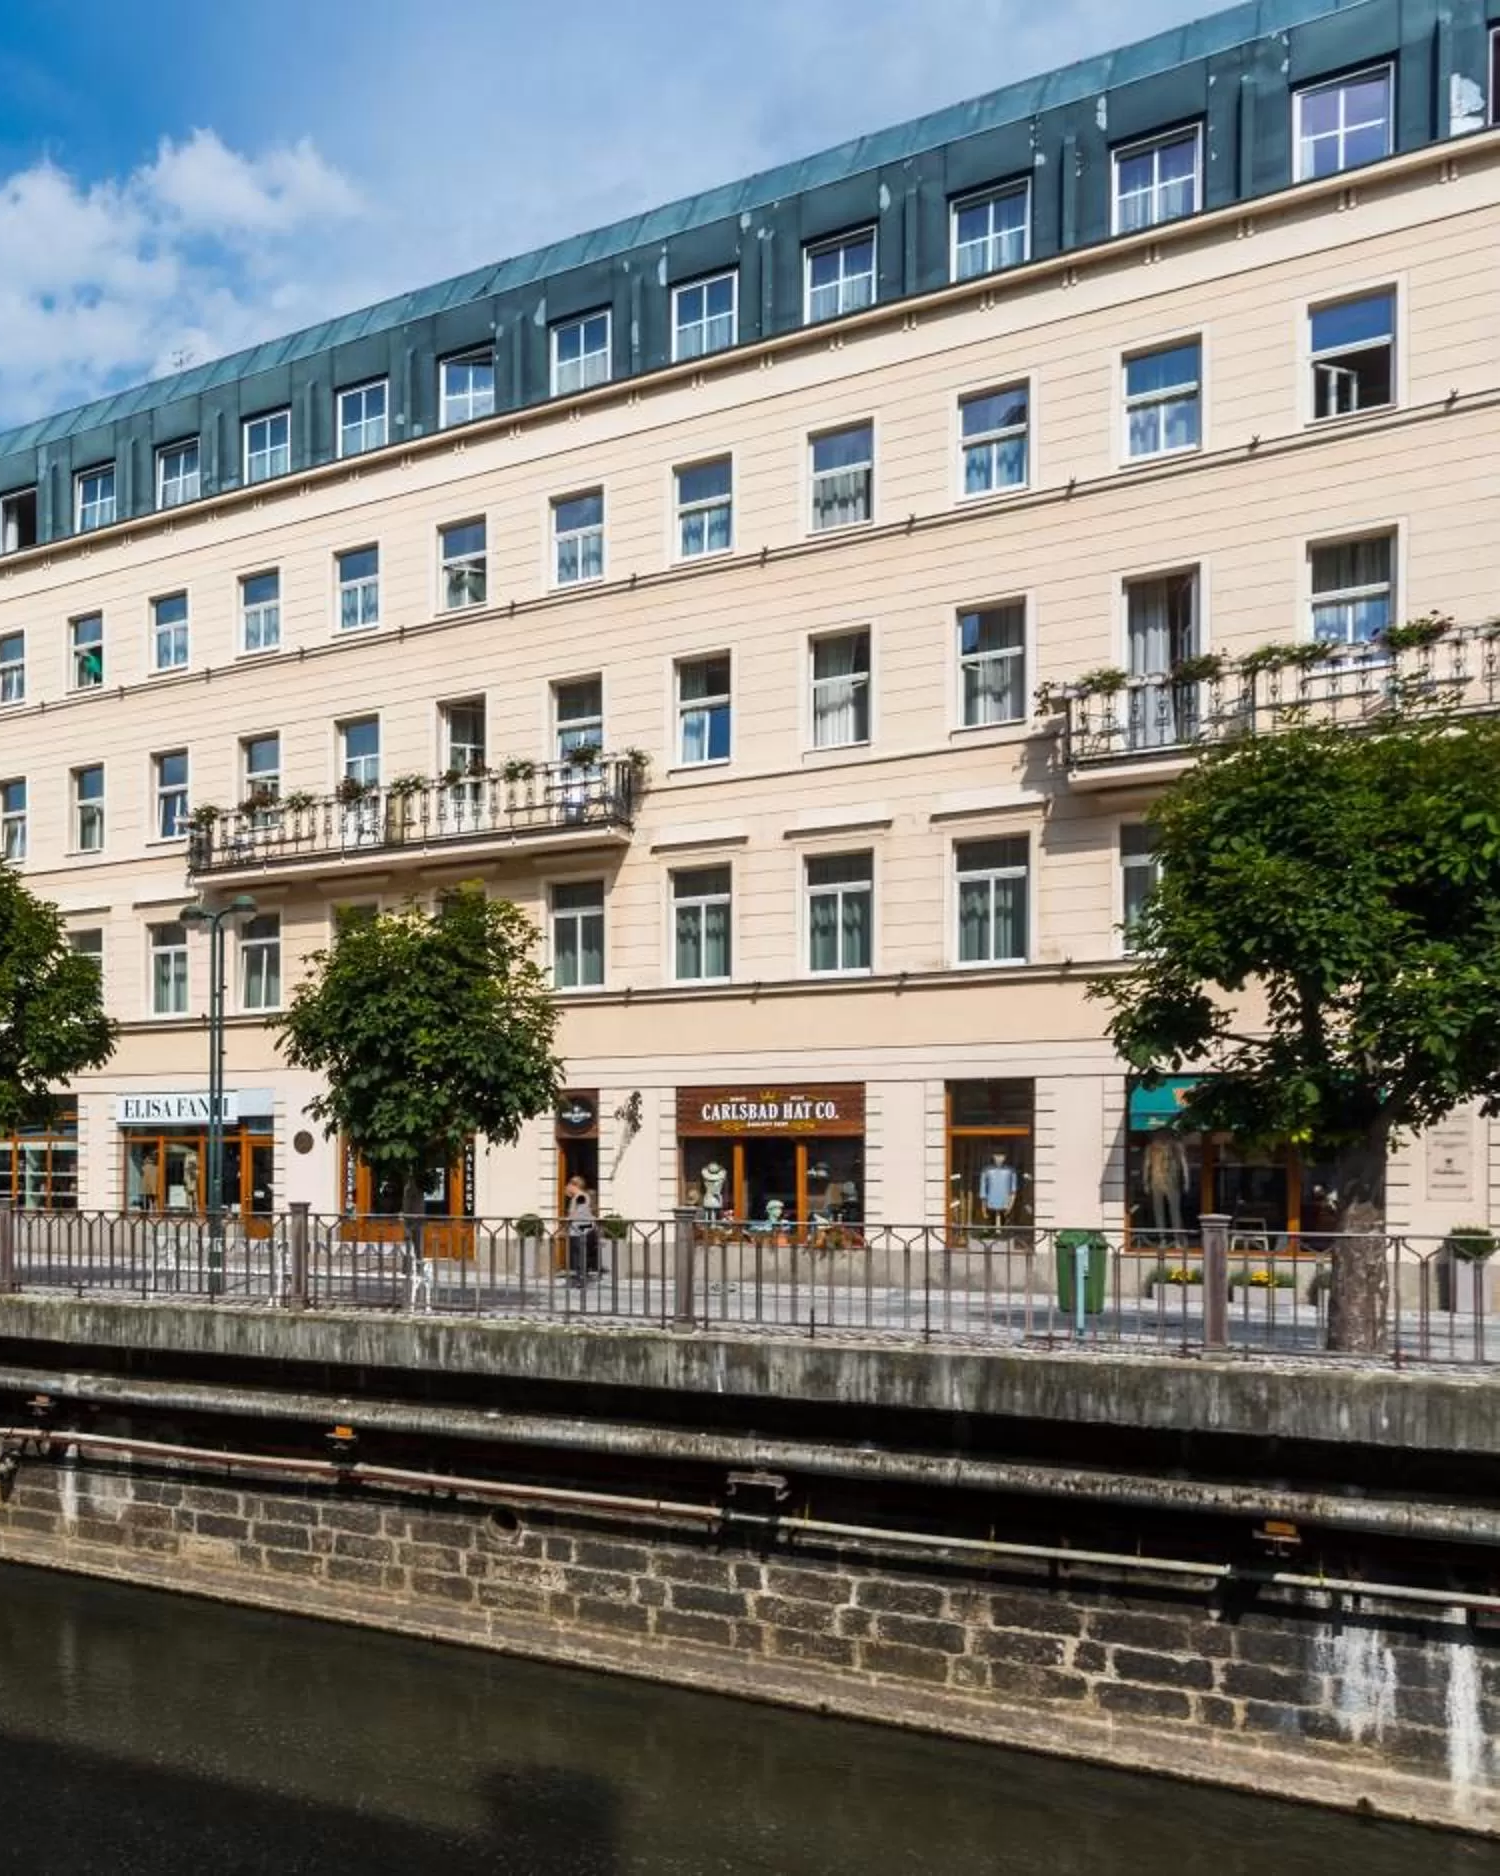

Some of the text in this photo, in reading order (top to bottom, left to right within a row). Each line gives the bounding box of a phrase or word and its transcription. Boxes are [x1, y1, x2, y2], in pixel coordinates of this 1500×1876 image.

[124, 1097, 229, 1119] ELISA FANI
[701, 1101, 840, 1122] CARLSBAD HAT CO.
